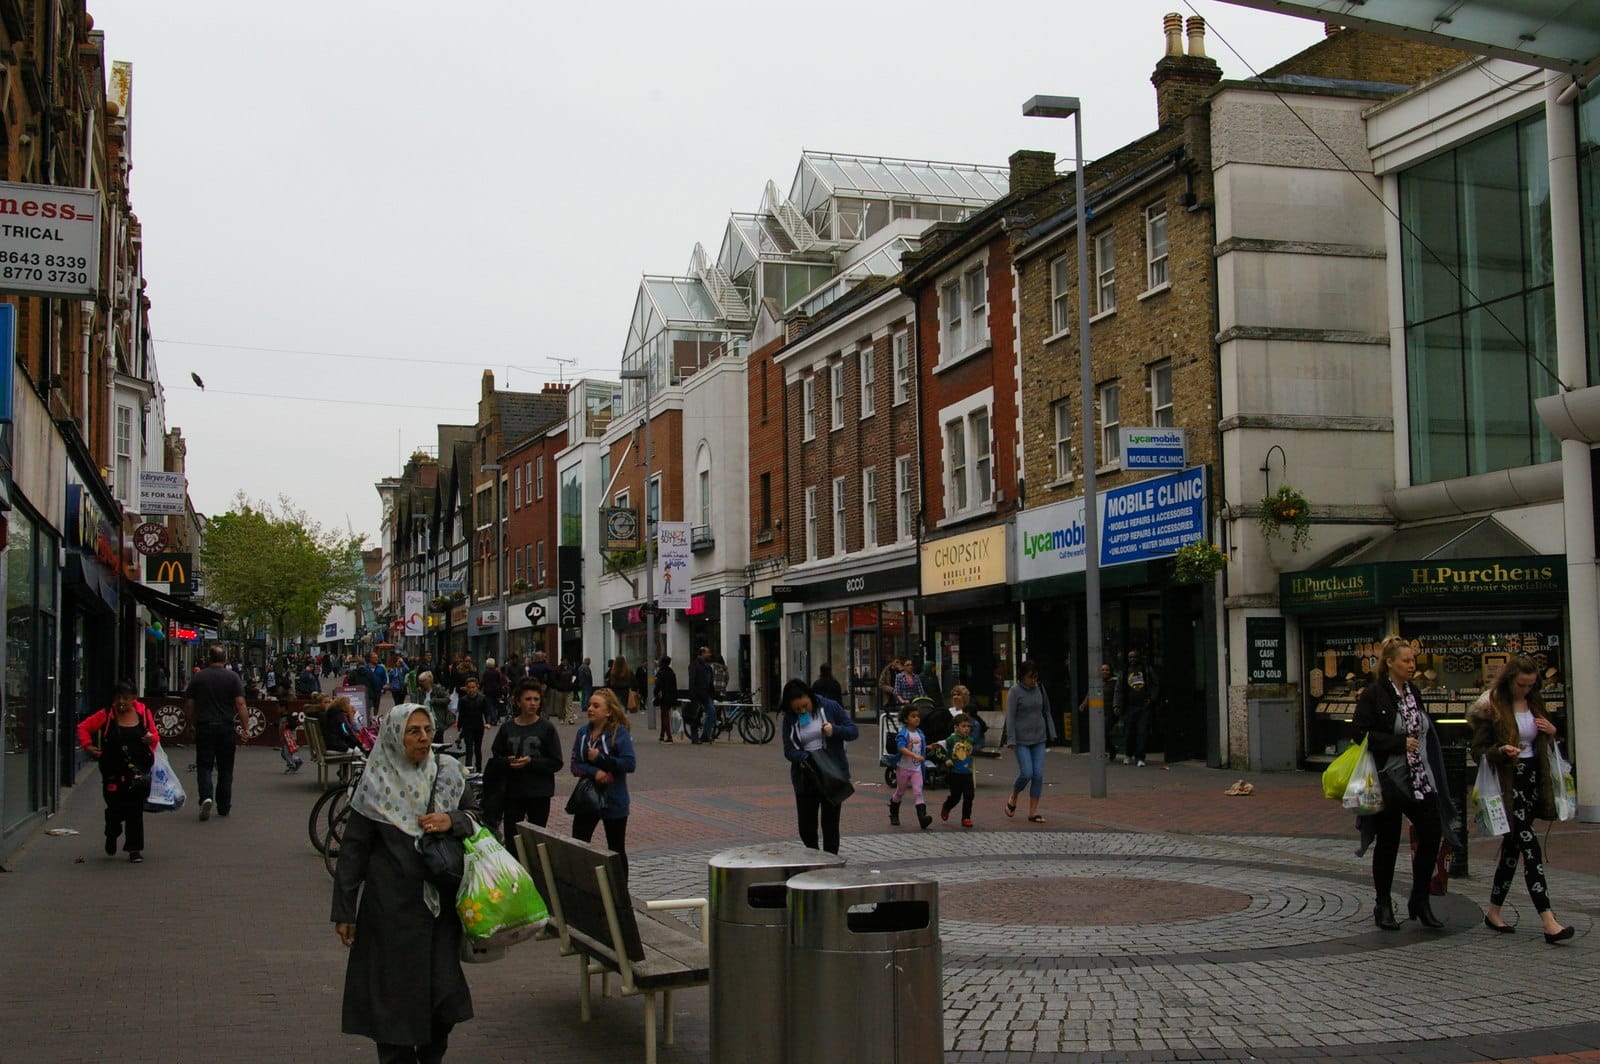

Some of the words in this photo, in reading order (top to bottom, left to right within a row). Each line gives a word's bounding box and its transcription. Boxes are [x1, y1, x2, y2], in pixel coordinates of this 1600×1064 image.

[0, 199, 75, 220] ness
[2, 225, 64, 241] TRICAL
[0, 251, 40, 265] 8643
[45, 255, 86, 269] 8339
[3, 266, 43, 281] 8770
[48, 270, 87, 284] 3730
[1129, 434, 1180, 443] Lycamobile
[1129, 455, 1157, 464] MOBILE
[1159, 455, 1184, 464] CLINIC
[1108, 488, 1154, 518] MOBILE
[1157, 477, 1202, 507] CLINIC
[1129, 515, 1150, 527] REPAIRS
[1156, 506, 1193, 521] ACCESSORIES
[140, 525, 161, 535] COSTA
[1110, 532, 1129, 544] LAPTOP
[1130, 528, 1151, 541] REPAIRS
[1157, 520, 1193, 535] ACCESSORIES
[138, 542, 164, 553] COFFEE
[934, 536, 990, 568] CHOPSTIX
[1111, 544, 1137, 556] UNLOCKING
[1159, 536, 1179, 547] DAMAGE
[1410, 563, 1552, 585] H.Purchens
[846, 576, 864, 592] ecco
[1292, 575, 1365, 593] H.Purchens
[1401, 584, 1448, 594] Jewellers
[1452, 584, 1462, 592] &
[1463, 583, 1499, 593] Repair
[1501, 581, 1558, 593] Specialists
[562, 580, 575, 625] next
[528, 606, 542, 617] JD
[1254, 639, 1279, 648] INSTANT
[1259, 649, 1275, 658] CASH
[1261, 660, 1273, 668] FOR
[1253, 670, 1265, 678] OLD
[1266, 670, 1282, 678] GOLD
[158, 706, 181, 717] COSTA
[156, 723, 184, 737] COFFEE
